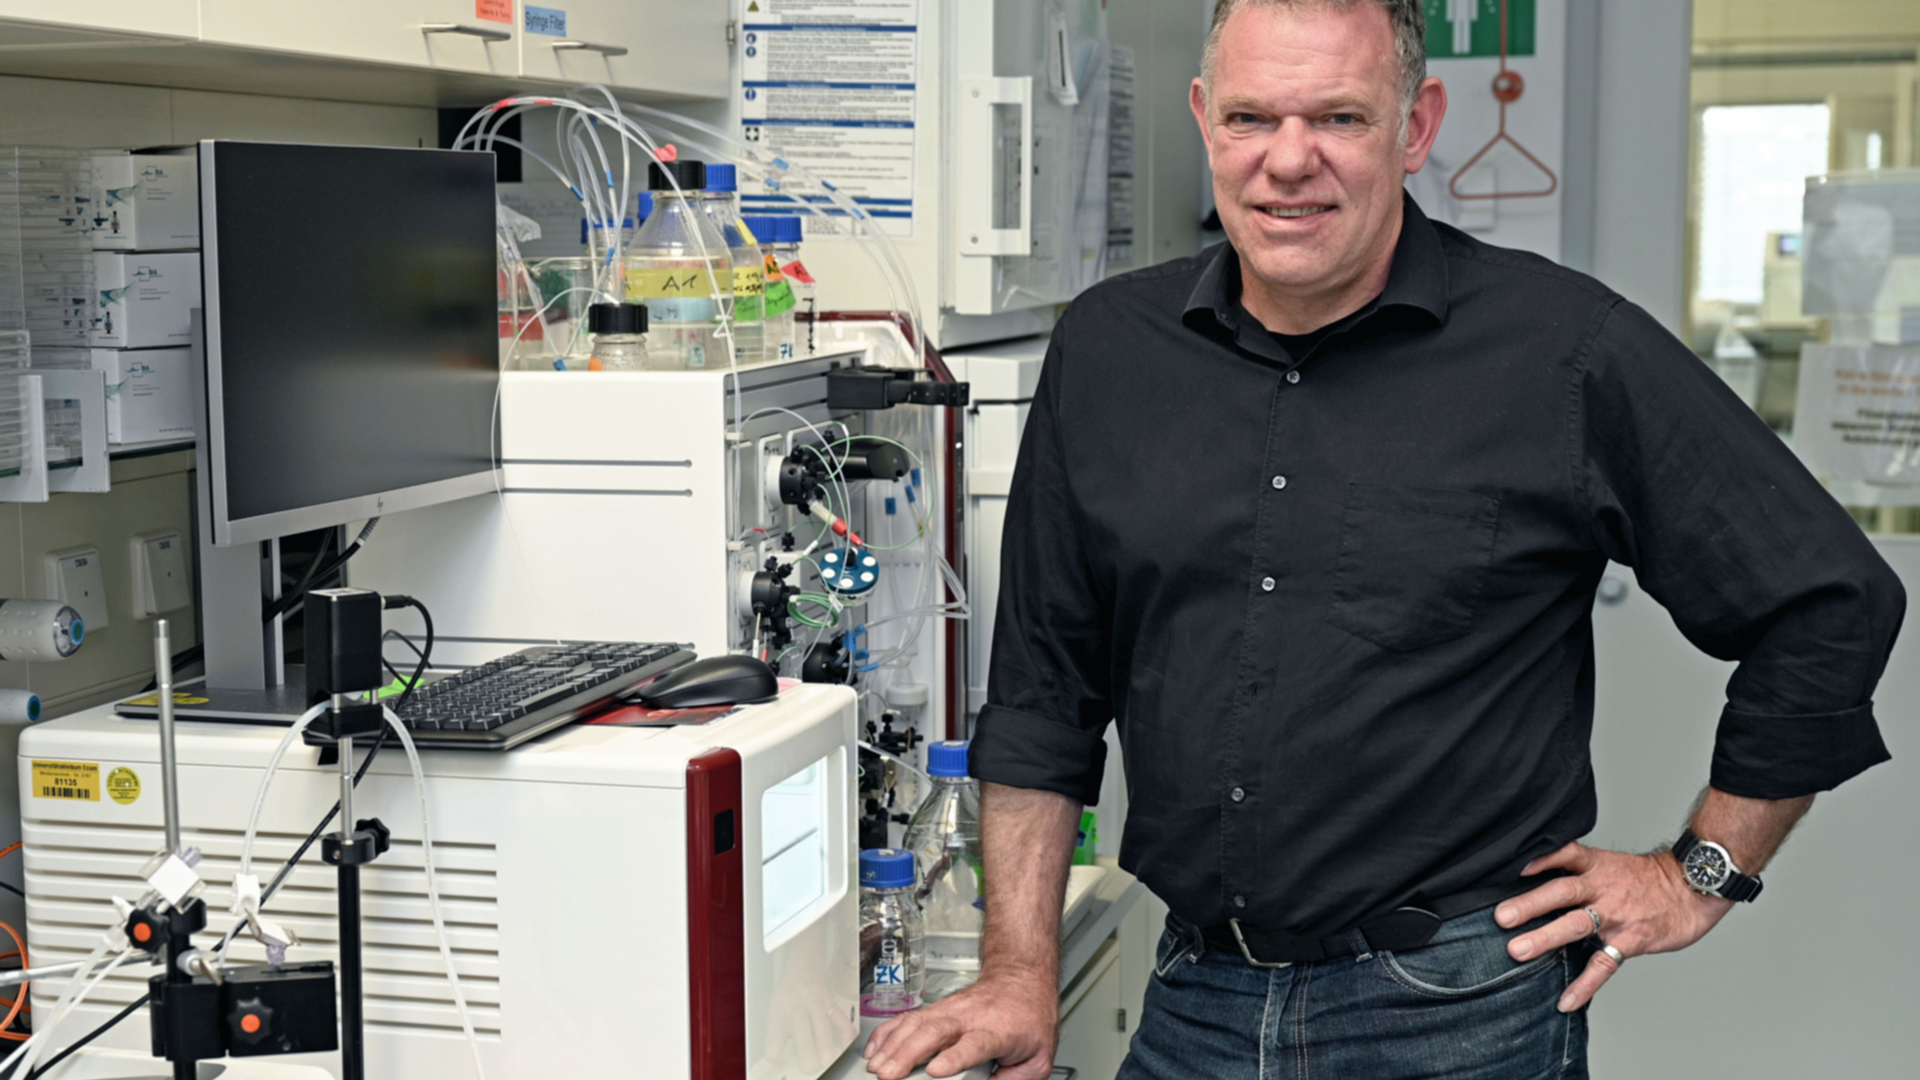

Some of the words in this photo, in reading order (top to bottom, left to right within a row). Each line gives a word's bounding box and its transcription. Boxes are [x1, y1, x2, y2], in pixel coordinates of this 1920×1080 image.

[525, 11, 549, 31] Syringe
[549, 14, 565, 30] Filter
[876, 964, 901, 984] ZK
